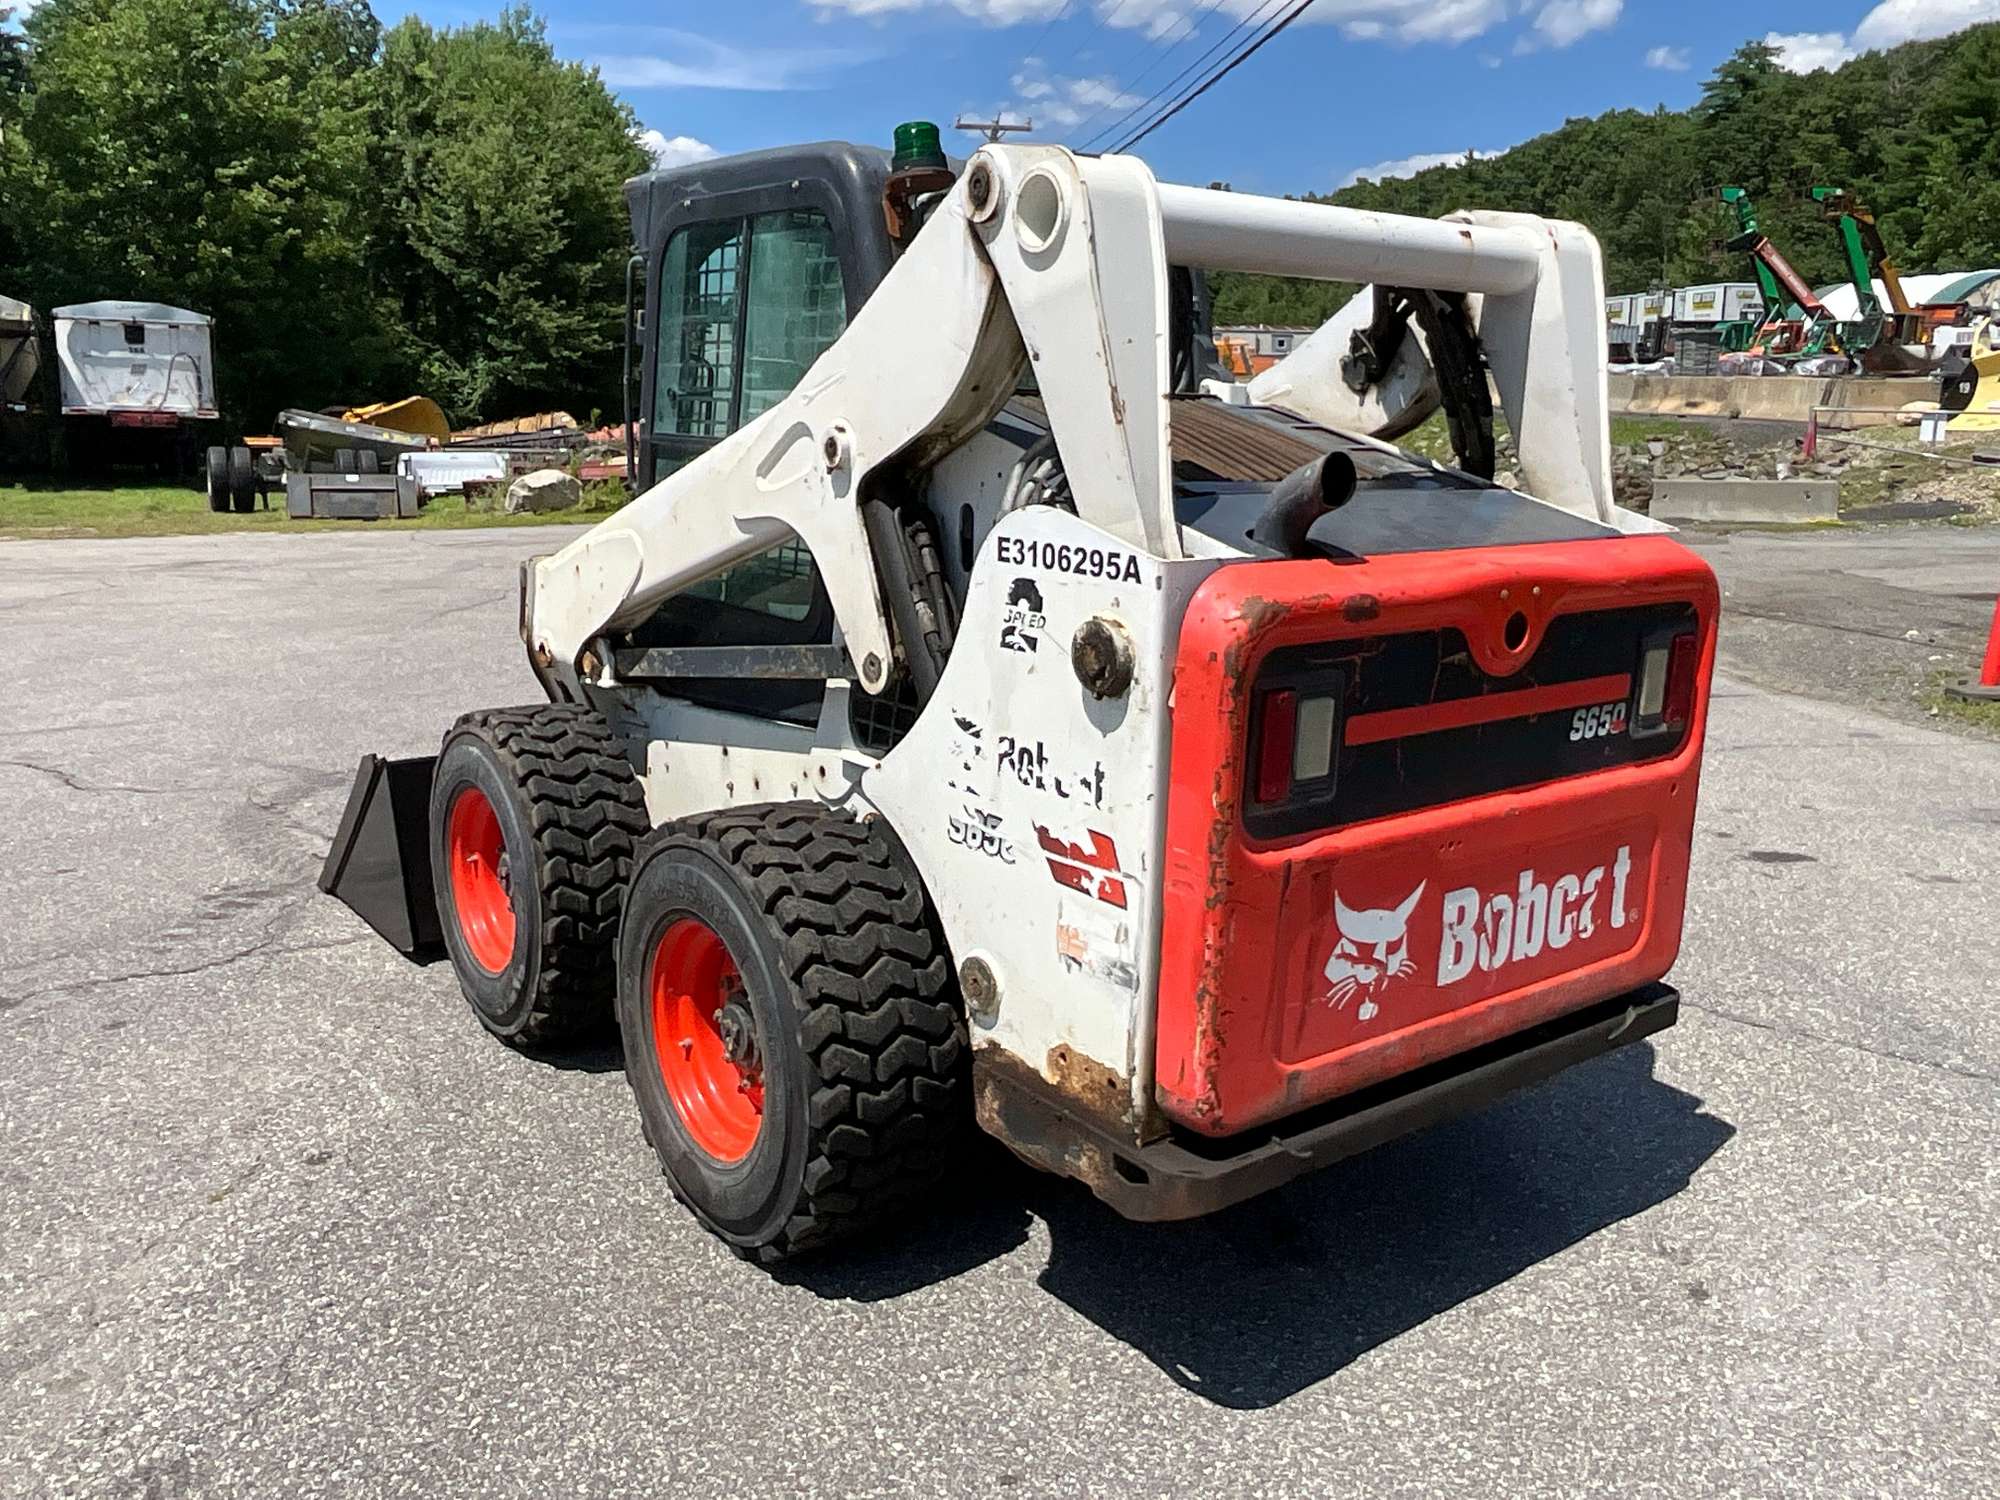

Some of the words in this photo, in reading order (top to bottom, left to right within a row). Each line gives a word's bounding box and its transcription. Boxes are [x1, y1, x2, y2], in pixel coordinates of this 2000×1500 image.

[997, 536, 1142, 584] E3106295A
[1569, 701, 1627, 741] S650
[1437, 845, 1631, 987] Bobcat
